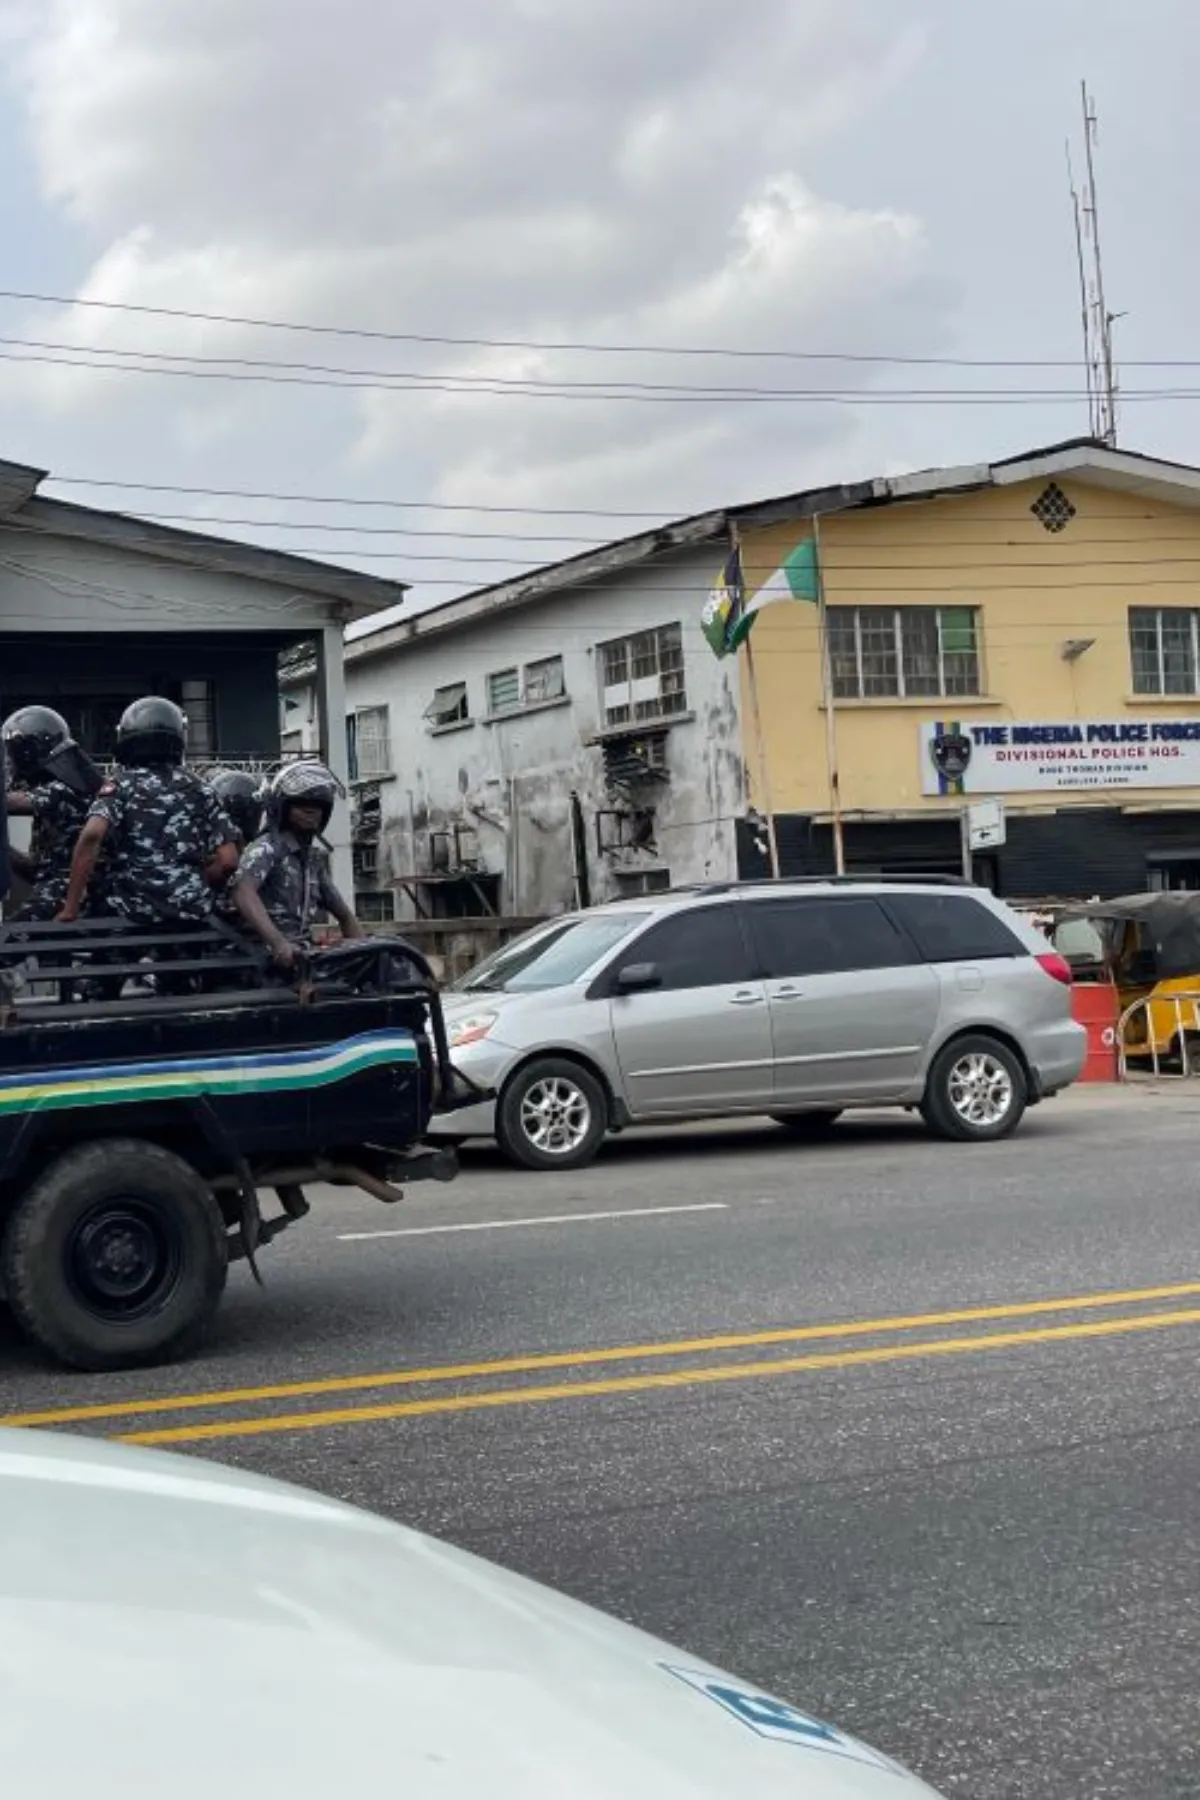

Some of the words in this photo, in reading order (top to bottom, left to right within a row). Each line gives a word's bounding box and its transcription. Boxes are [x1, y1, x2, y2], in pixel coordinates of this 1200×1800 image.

[970, 726, 1009, 745] THE
[1087, 723, 1149, 742] POLICE
[995, 748, 1088, 762] DIVISIONAL
[1091, 747, 1145, 760] POLICE
